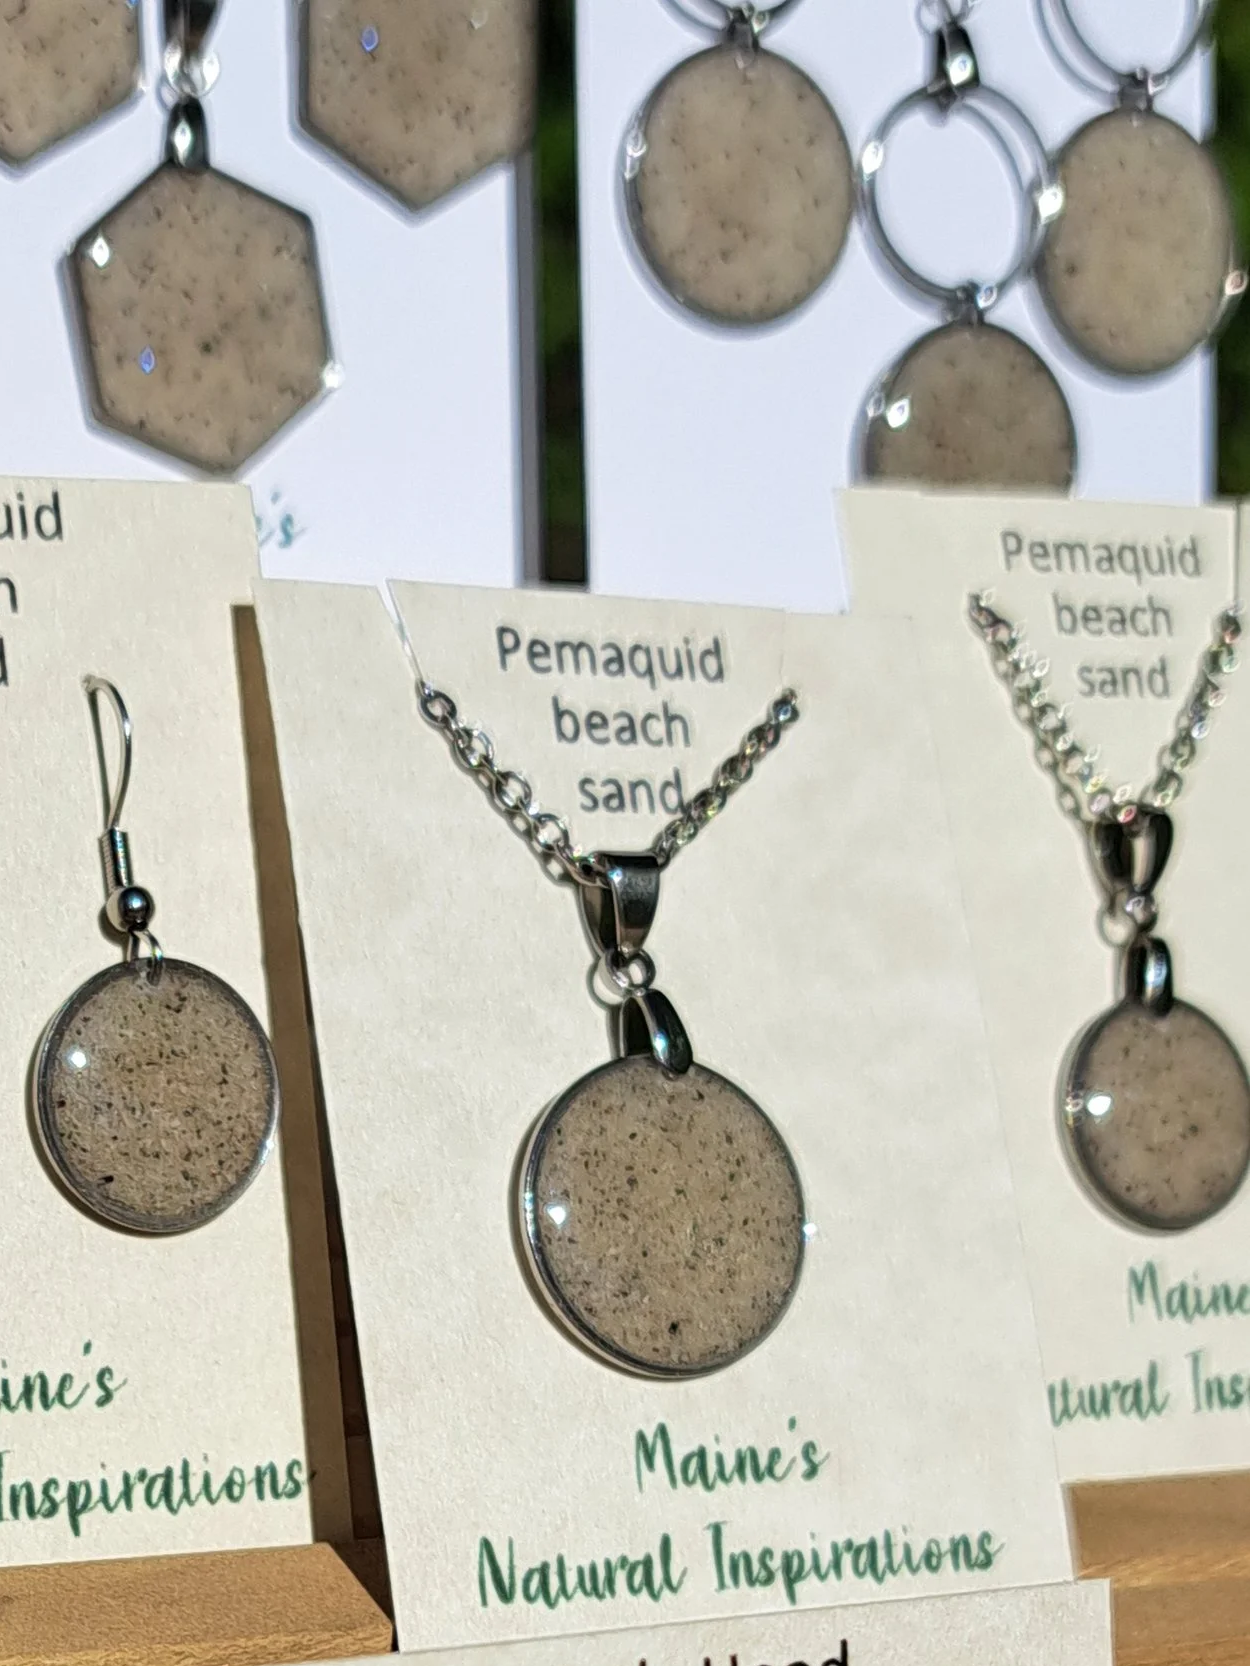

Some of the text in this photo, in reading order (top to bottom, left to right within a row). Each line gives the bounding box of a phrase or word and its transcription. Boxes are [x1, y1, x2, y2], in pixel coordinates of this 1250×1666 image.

[1000, 530, 1204, 592] Pemaquid
[1055, 593, 1176, 638] beach
[496, 625, 725, 688] Pemaquid
[1076, 655, 1172, 702] sand
[552, 697, 691, 750] beach
[579, 769, 686, 820] sand
[634, 1416, 831, 1493] Maine's
[477, 1520, 1006, 1610] Natural Inspirations
